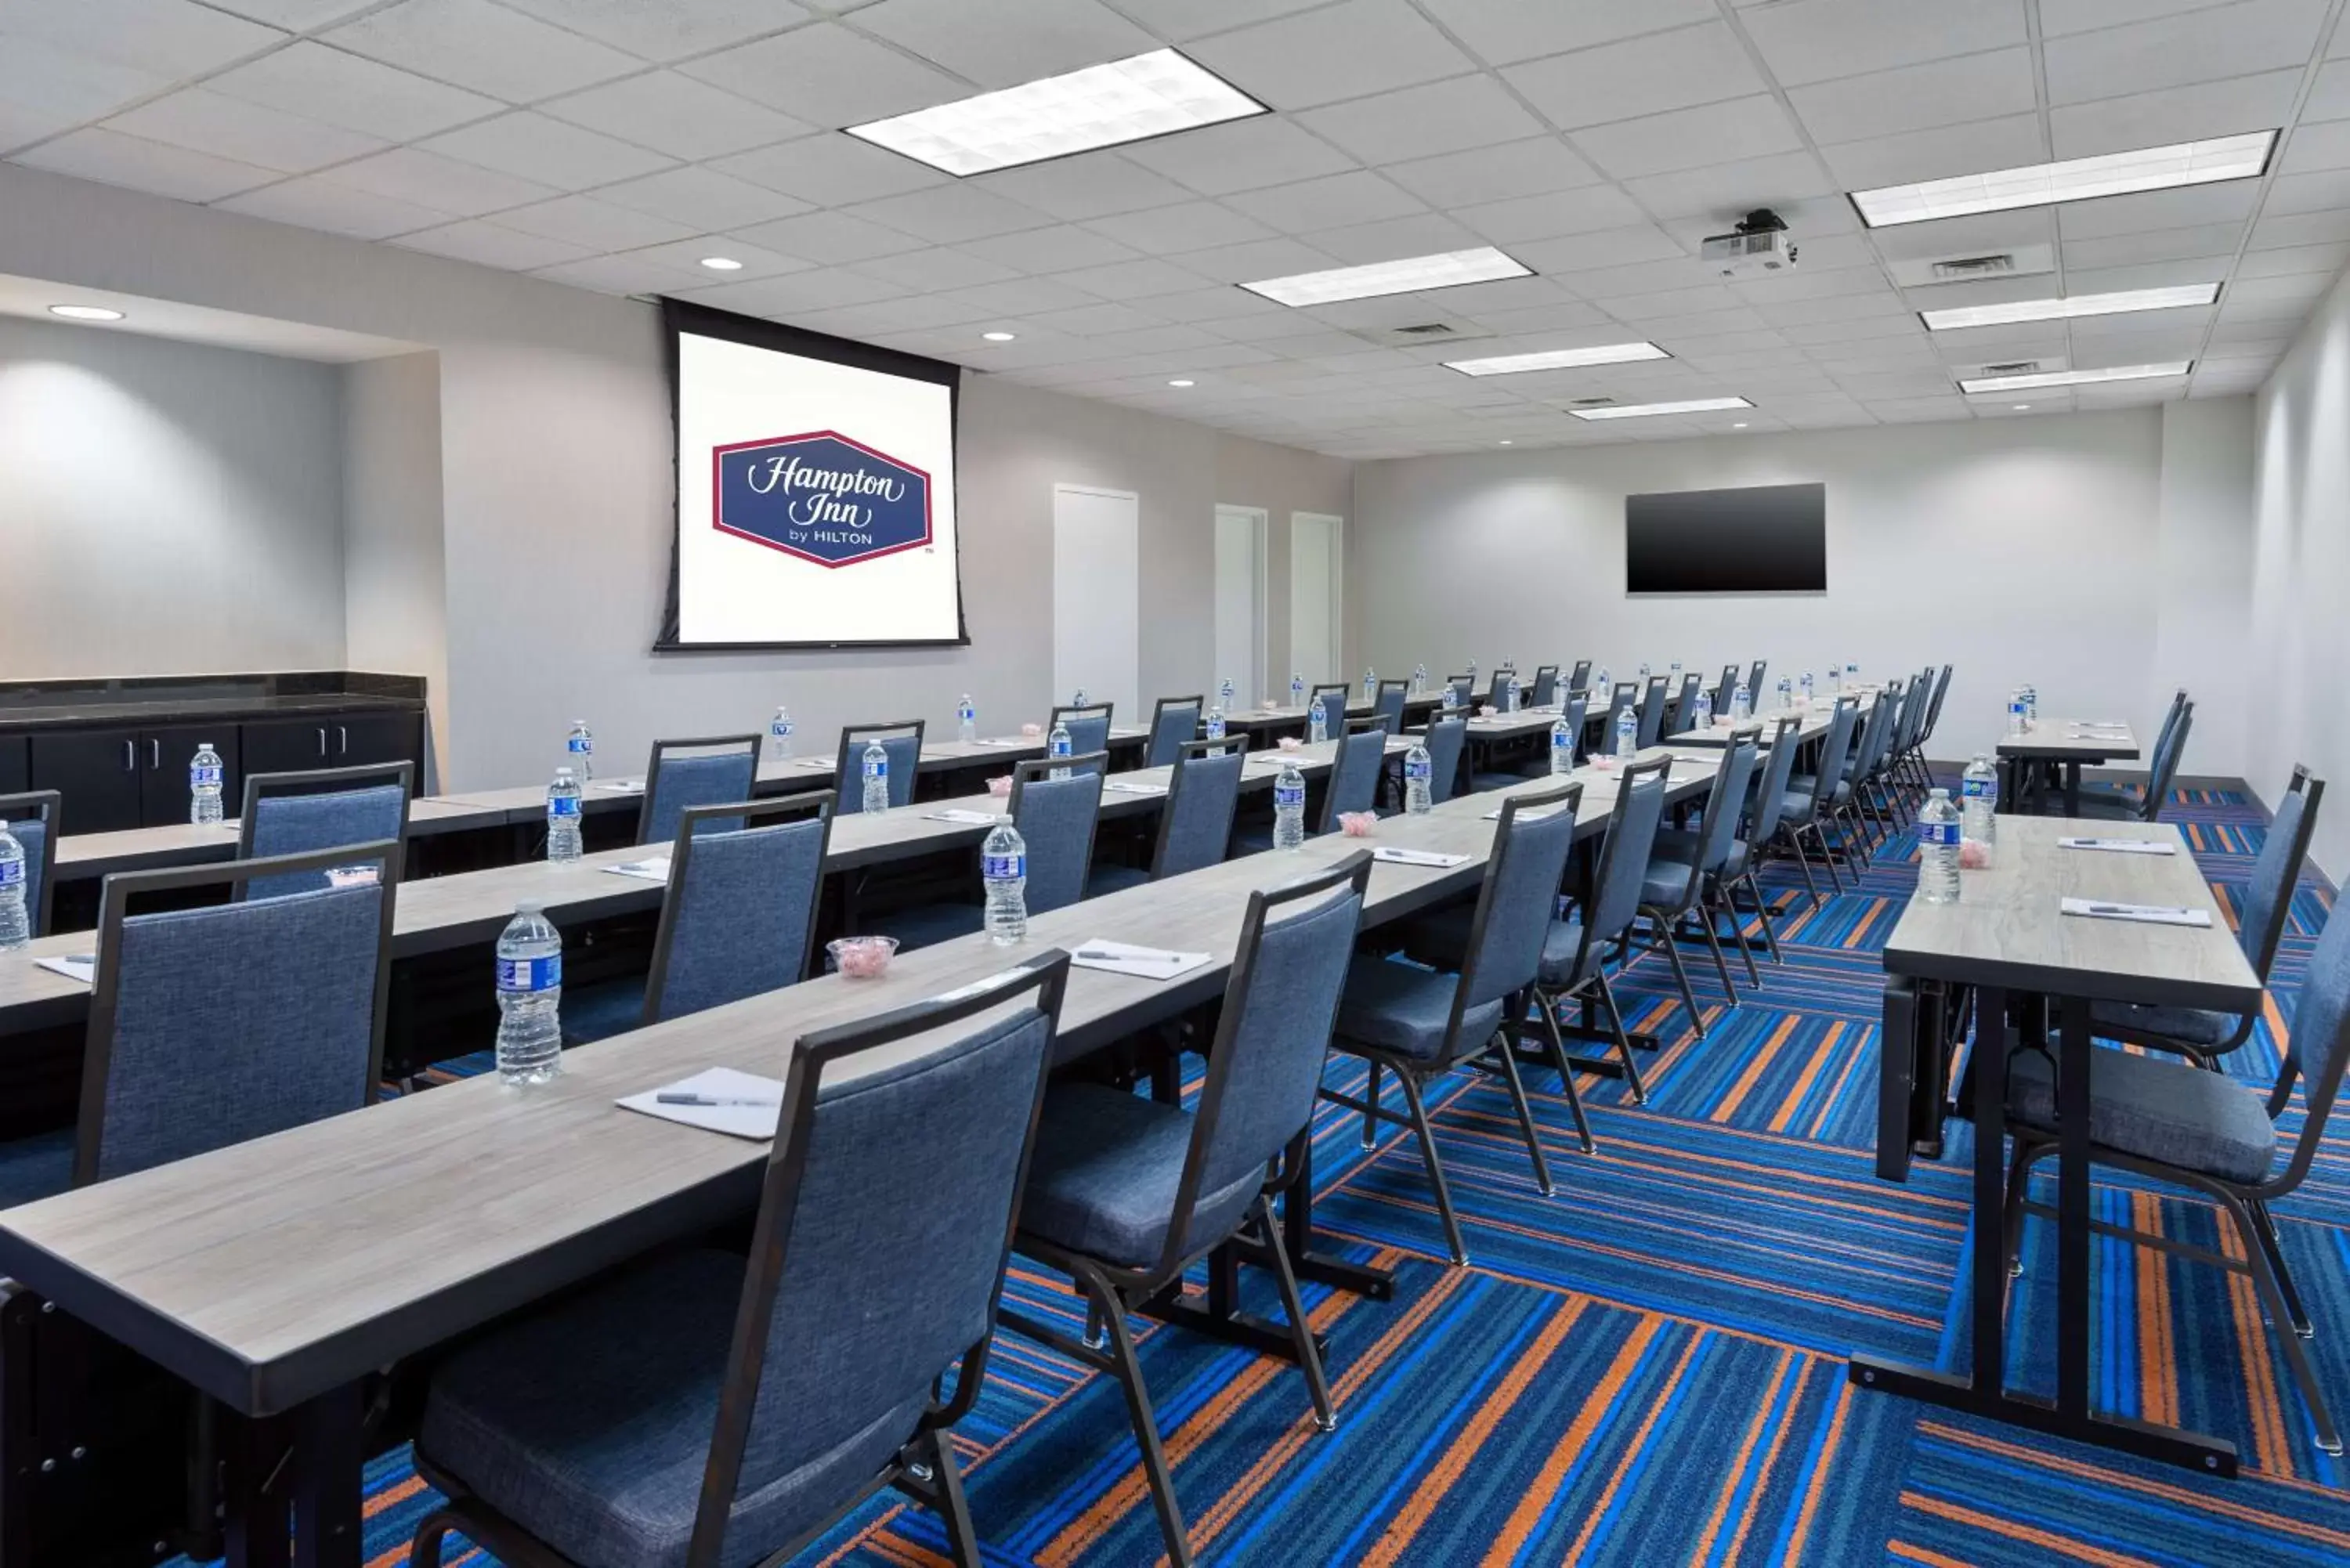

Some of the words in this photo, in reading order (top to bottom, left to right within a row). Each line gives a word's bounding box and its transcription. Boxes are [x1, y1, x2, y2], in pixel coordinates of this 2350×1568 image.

[748, 456, 905, 502] Hampton
[789, 493, 872, 528] Inn
[789, 529, 808, 543] by
[814, 530, 872, 545] HILTON
